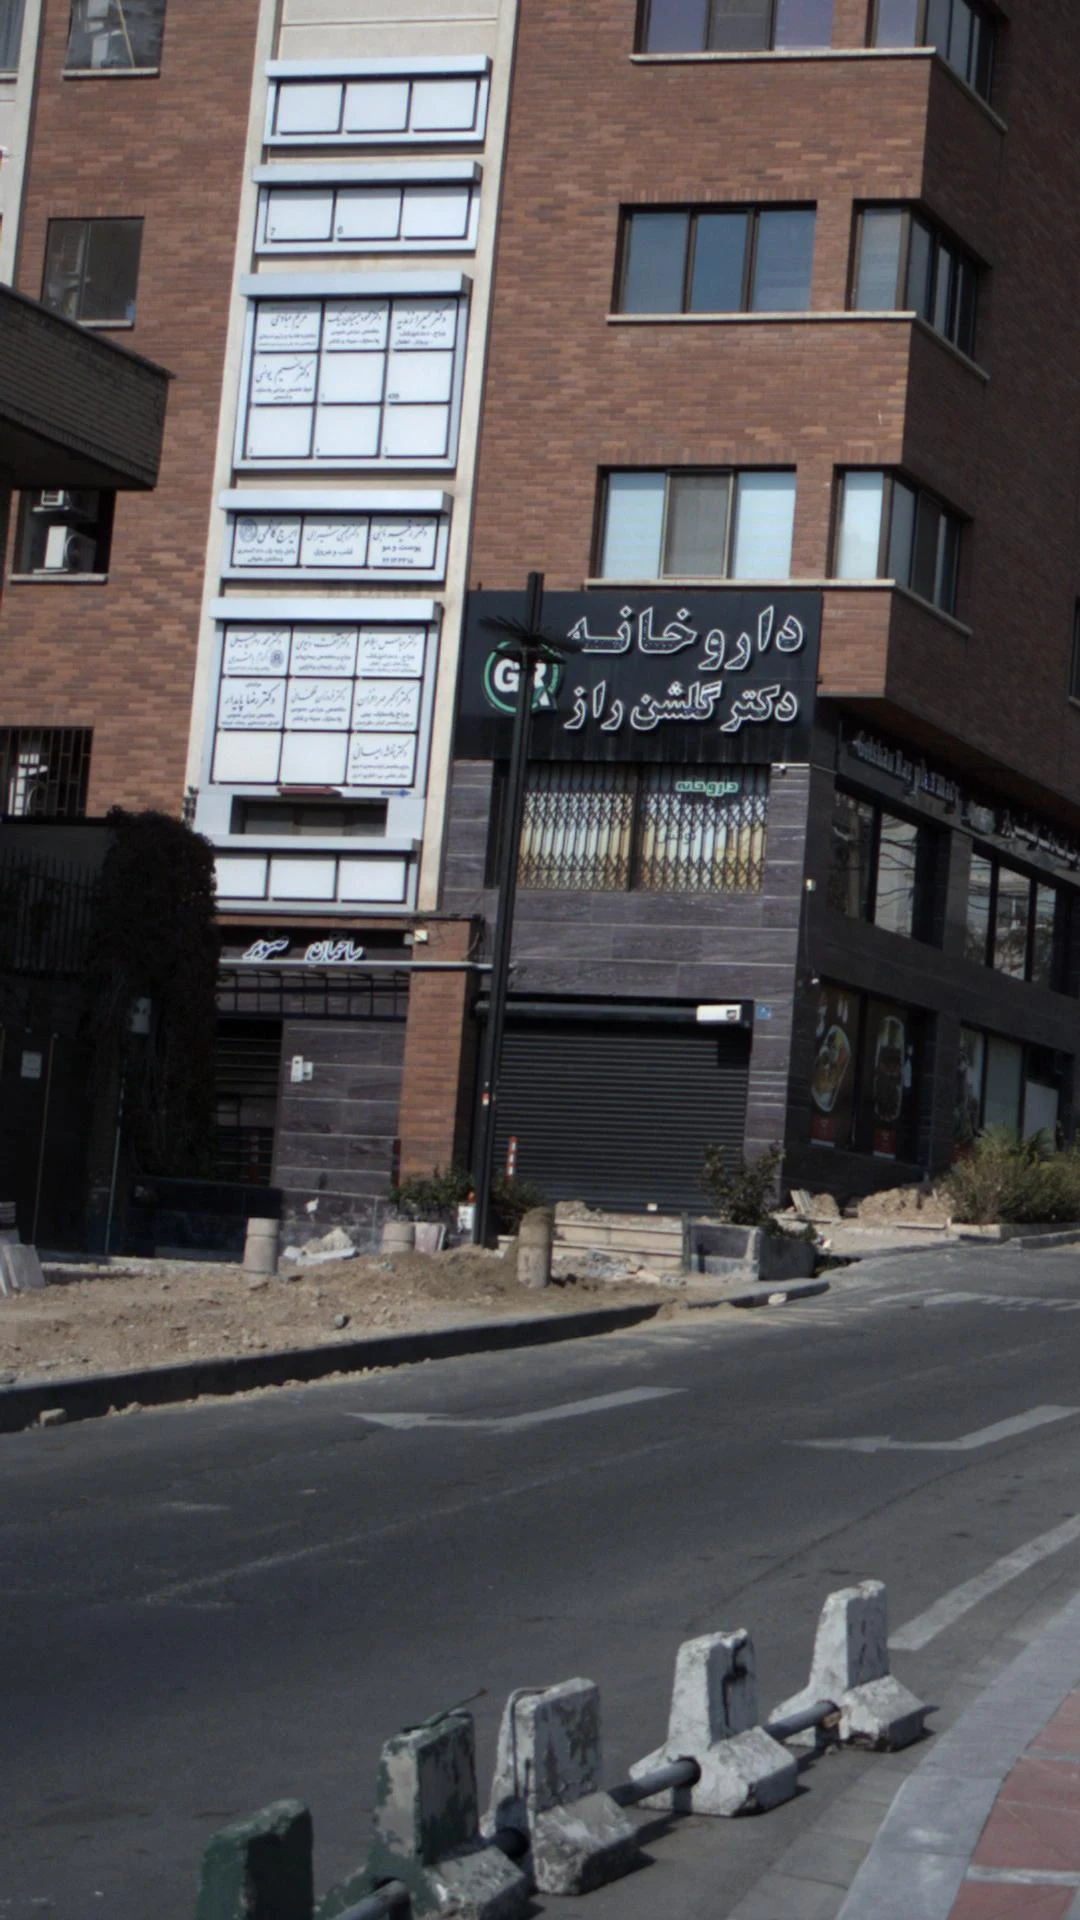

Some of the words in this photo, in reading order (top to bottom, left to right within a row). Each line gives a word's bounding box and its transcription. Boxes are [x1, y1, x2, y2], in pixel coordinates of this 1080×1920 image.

[567, 604, 804, 671] داروخانه
[255, 682, 282, 709] دکتر
[564, 681, 624, 731] راز
[629, 681, 723, 731] گلشن
[720, 685, 799, 732] دکتر
[674, 778, 740, 797] داروخانه
